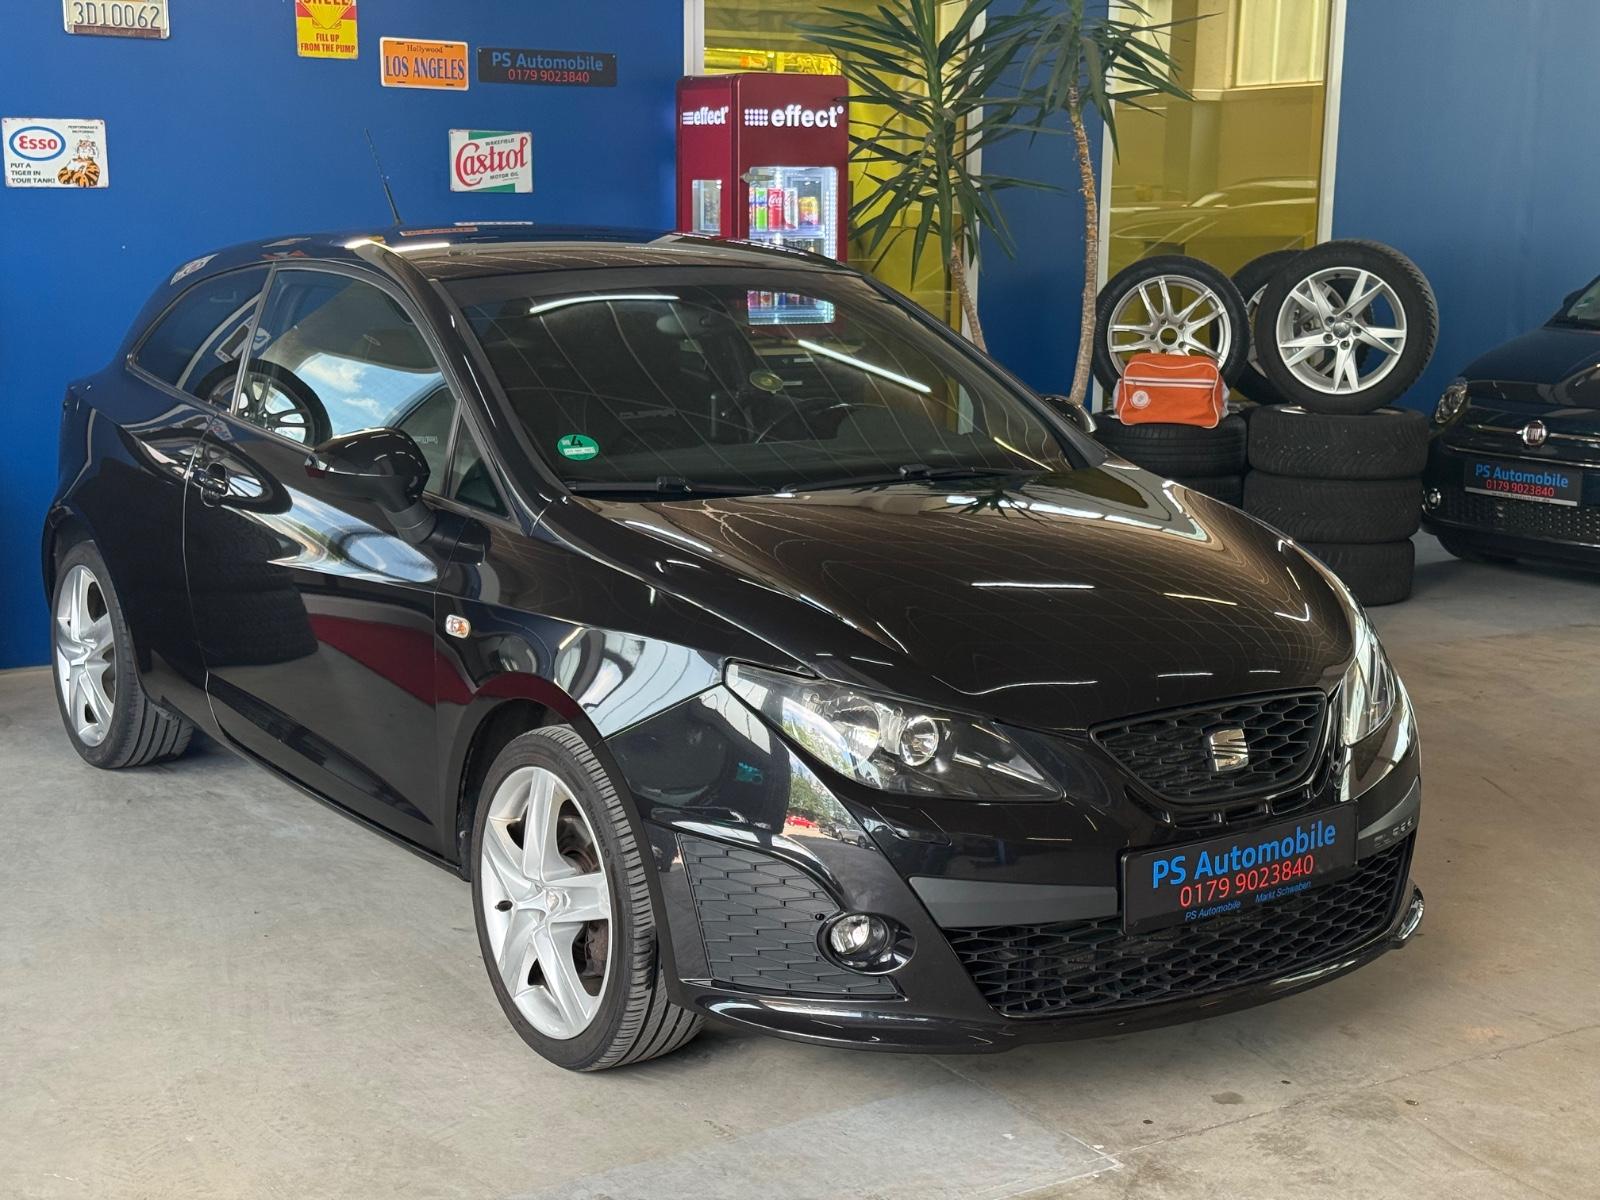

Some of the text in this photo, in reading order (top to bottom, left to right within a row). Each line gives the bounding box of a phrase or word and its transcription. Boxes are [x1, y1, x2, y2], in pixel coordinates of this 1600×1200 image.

[73, 1, 160, 28] 3D10062
[301, 42, 355, 53] FROM THE PUMP
[316, 32, 340, 42] FILL UP
[407, 44, 443, 54] Hollywood
[385, 55, 465, 80] LOS ANGELES
[492, 51, 603, 72] PS Automobile
[508, 68, 590, 83] 0179 9023840
[485, 138, 515, 146] WAKEFIELD
[455, 136, 528, 187] Castrol
[490, 172, 509, 180] MOTOR
[1475, 464, 1569, 488] PS Automobile
[1486, 479, 1555, 497] 0179 9023840
[1153, 820, 1336, 888] PS Automobile
[1180, 854, 1314, 908] 0179 9023840
[1184, 881, 1312, 922] PS Automobile Markt Schwaben
